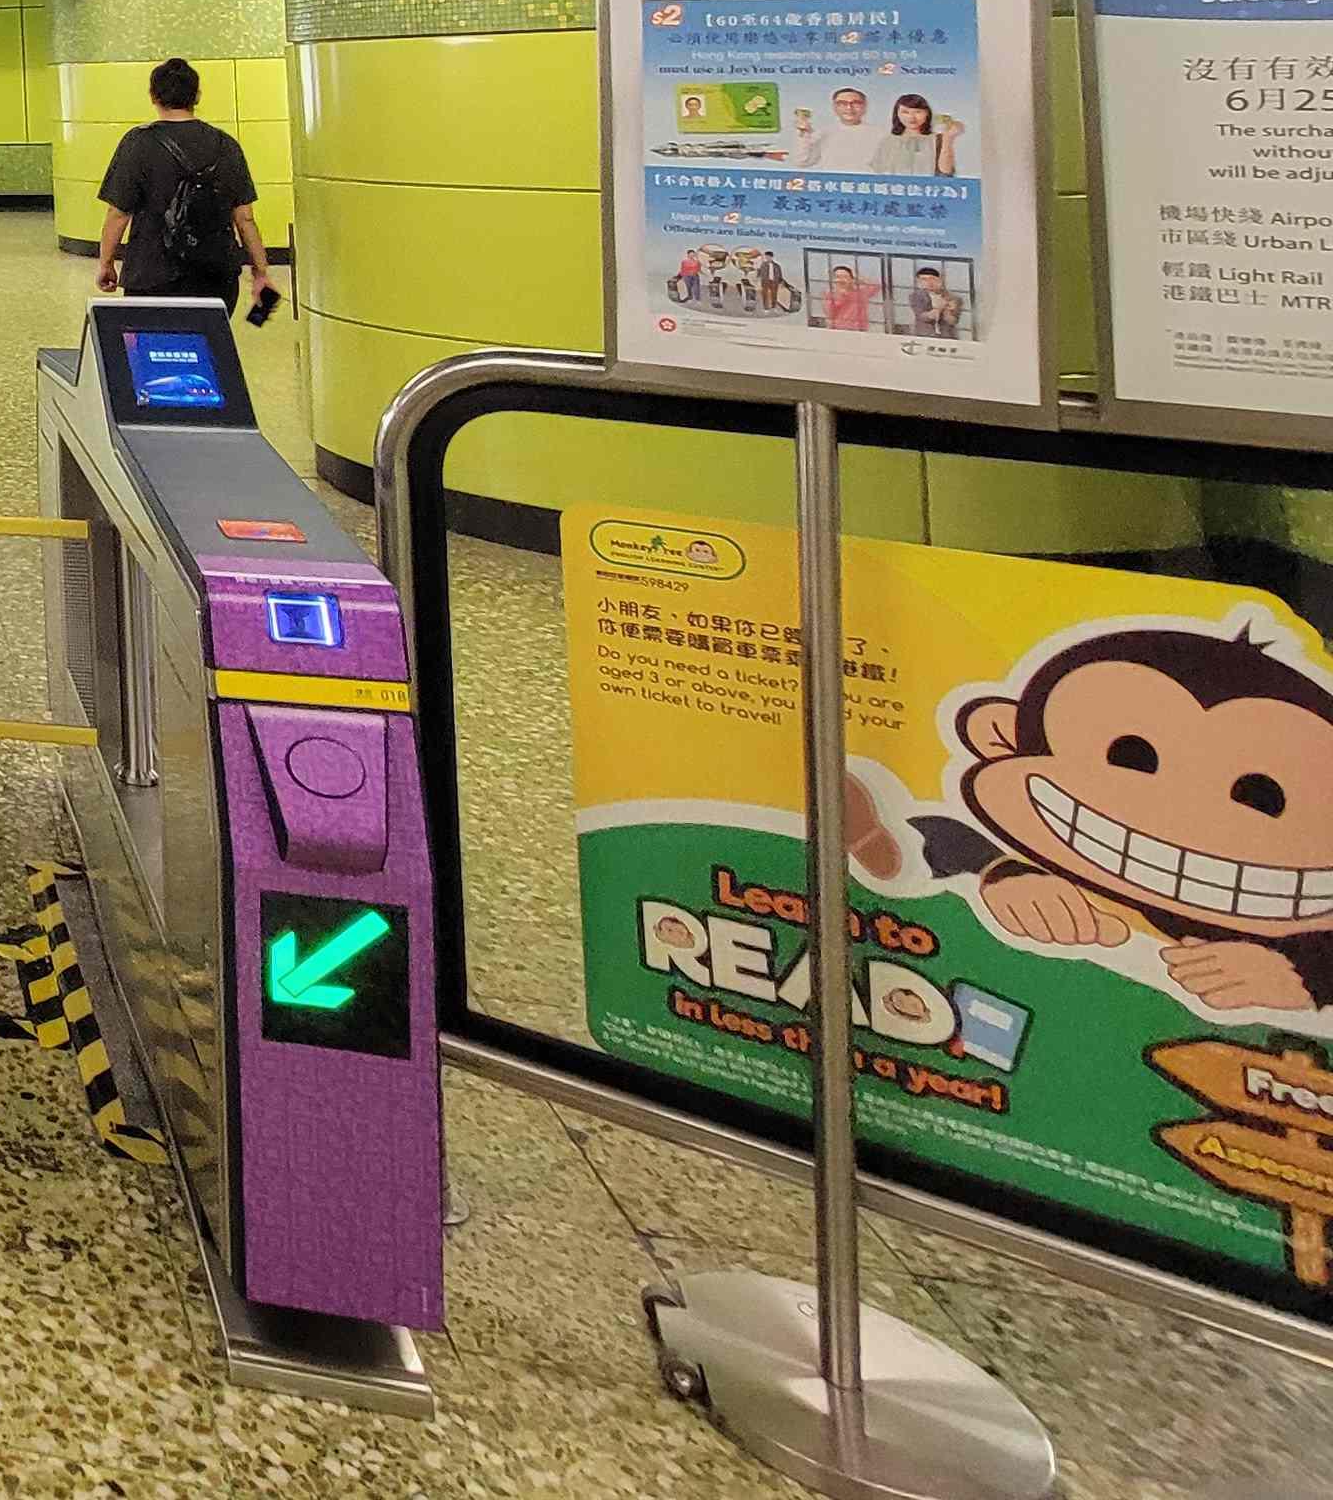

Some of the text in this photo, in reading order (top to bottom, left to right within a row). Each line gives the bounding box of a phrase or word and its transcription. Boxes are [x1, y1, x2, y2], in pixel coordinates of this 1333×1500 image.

[650, 3, 684, 27] $2
[659, 65, 689, 75] must
[693, 66, 714, 75] use
[780, 65, 814, 75] Card
[817, 66, 832, 75] to
[834, 65, 872, 77] enjoy
[900, 65, 958, 75] Scheme
[1217, 123, 1256, 137] The
[1209, 164, 1246, 179] will
[1252, 165, 1280, 180] be
[663, 223, 716, 236] Offenders
[717, 227, 734, 236] are
[737, 226, 765, 238] liable
[1244, 235, 1313, 250] Urban
[1218, 267, 1275, 285] Light
[1282, 270, 1324, 286] Rail
[1281, 295, 1333, 310] MTR
[610, 539, 654, 553] Monkey
[597, 644, 621, 661] Do
[627, 649, 660, 669] you
[664, 658, 711, 677] need
[717, 668, 730, 681] a
[736, 669, 799, 692] ticket?
[868, 696, 905, 713] are
[599, 664, 644, 684] aged
[649, 670, 660, 684] 3
[665, 675, 687, 689] or
[760, 691, 796, 711] you
[859, 711, 905, 730] your
[600, 681, 635, 697] own
[641, 683, 691, 708] ticket
[696, 695, 715, 713] to
[873, 912, 937, 956] to
[674, 988, 705, 1021] in
[709, 1002, 774, 1044] less
[871, 1057, 899, 1082] a
[908, 1065, 1004, 1113] year!
